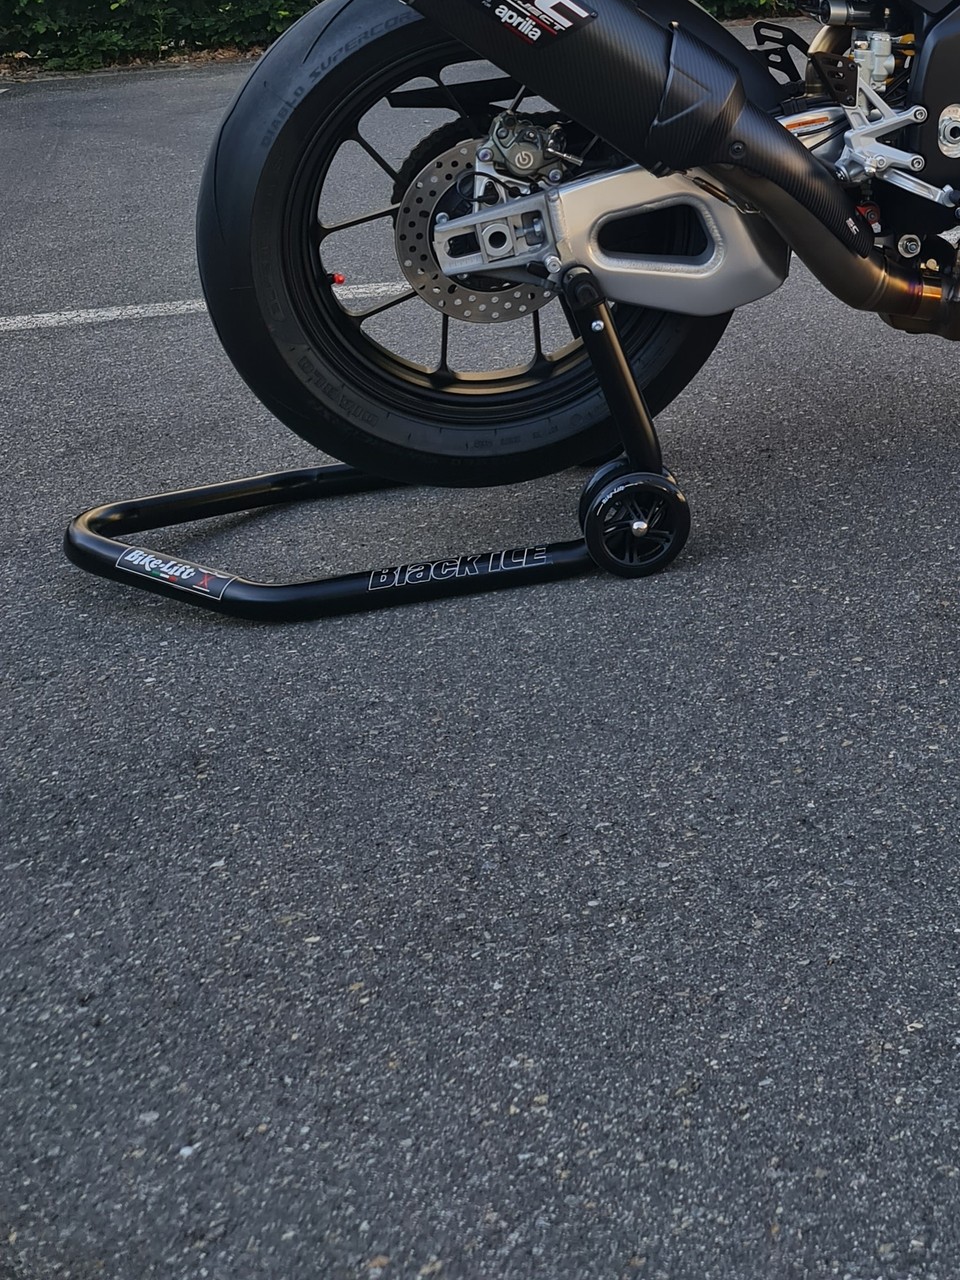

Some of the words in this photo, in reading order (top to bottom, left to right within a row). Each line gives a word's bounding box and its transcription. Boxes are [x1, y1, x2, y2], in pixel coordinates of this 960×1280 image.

[494, 4, 542, 41] aprilia
[124, 549, 197, 580] Bike-Lift
[368, 555, 482, 591] Black
[488, 547, 547, 572] ICE
